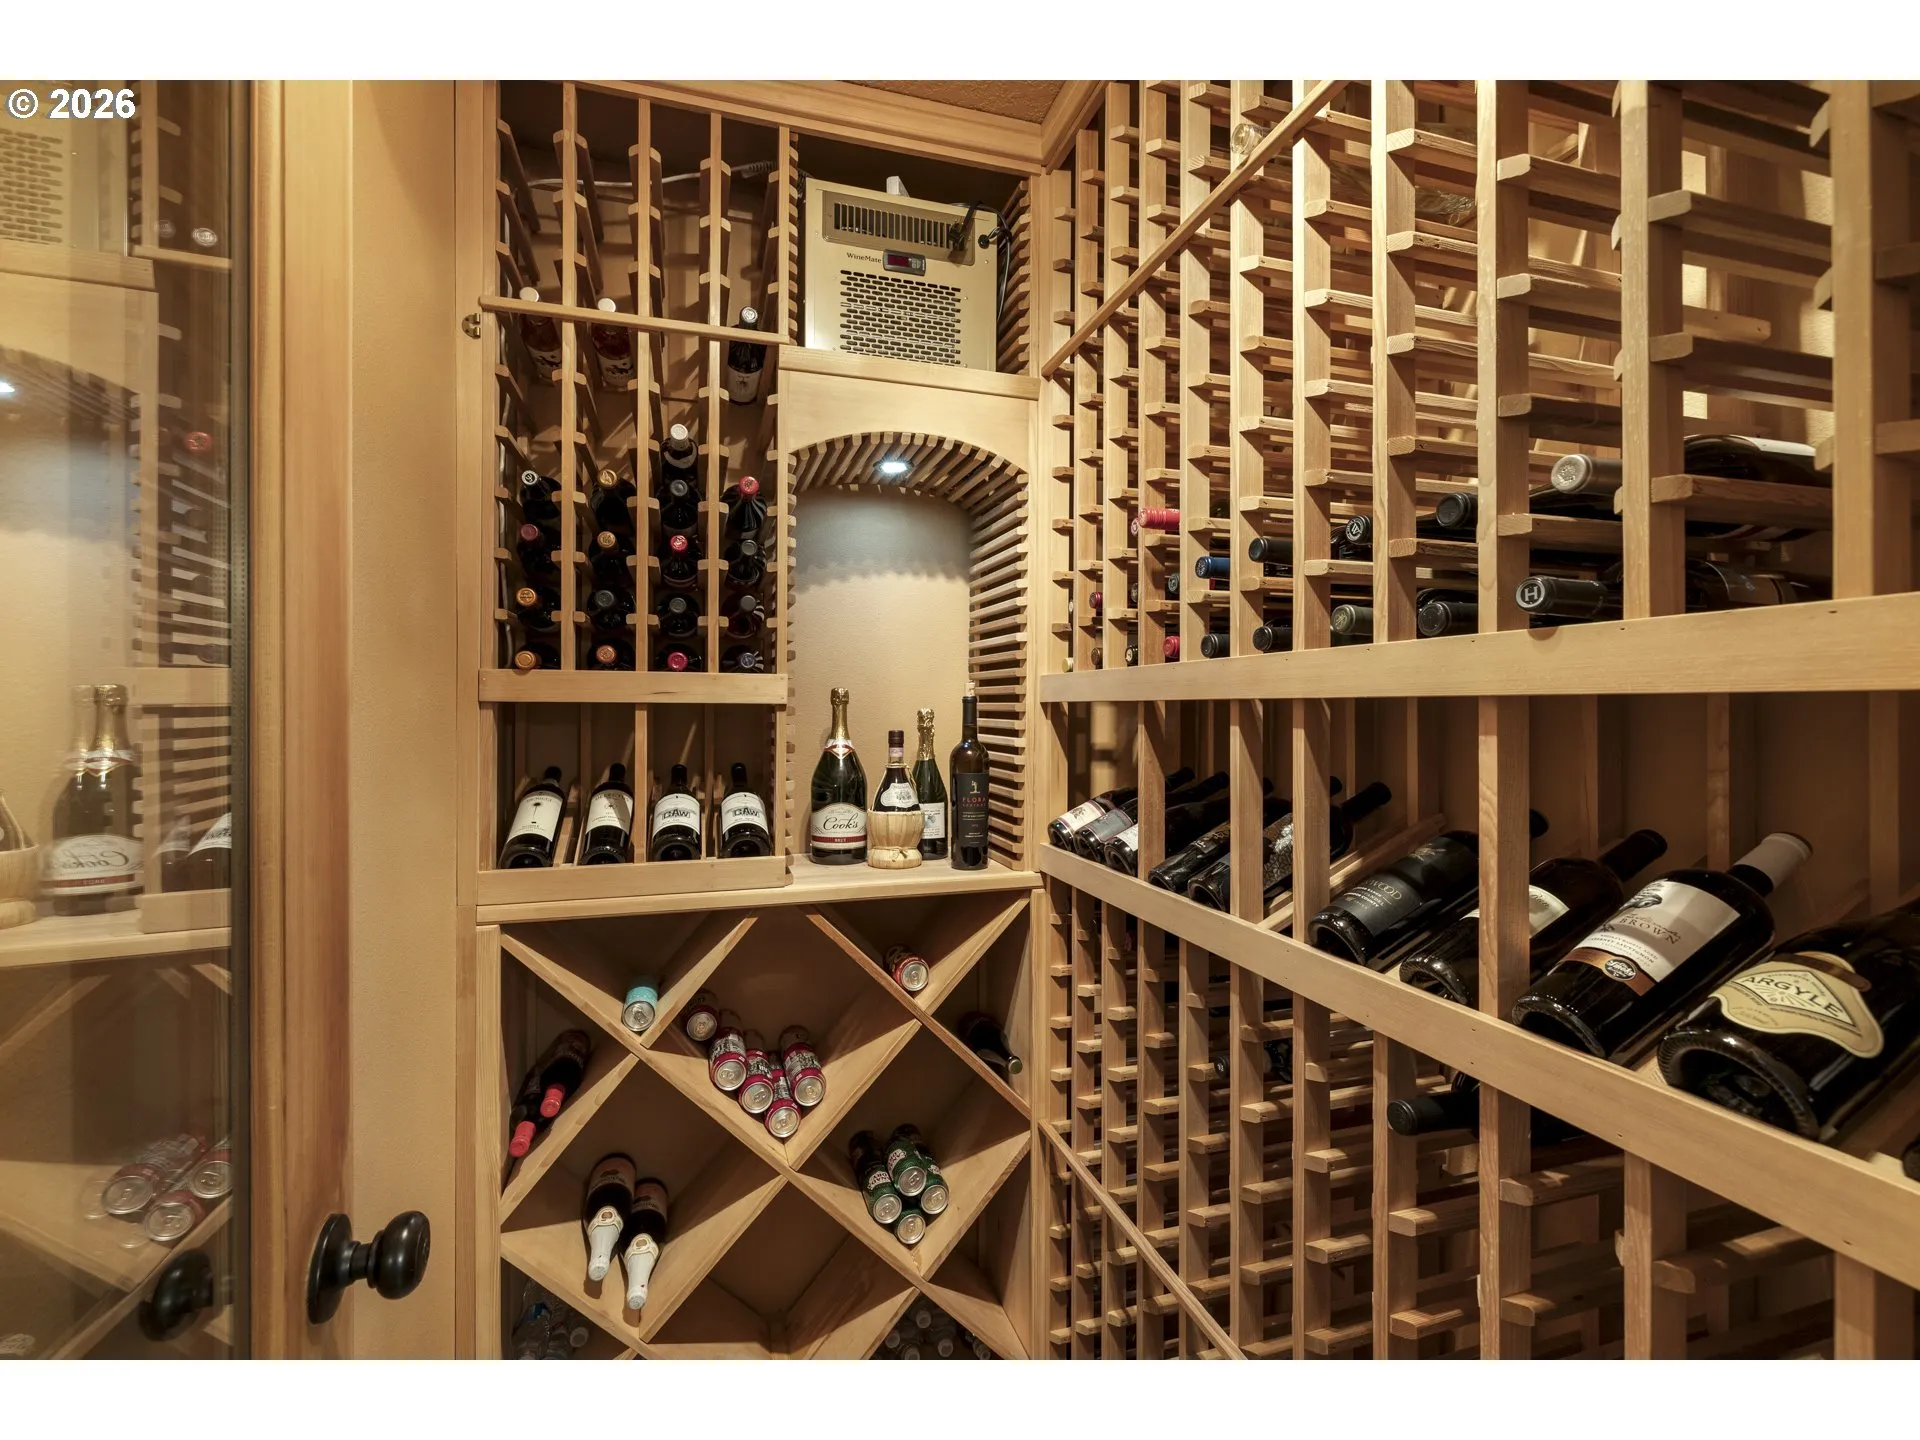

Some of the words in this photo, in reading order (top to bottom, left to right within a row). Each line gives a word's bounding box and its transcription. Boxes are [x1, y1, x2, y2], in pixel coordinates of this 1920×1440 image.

[846, 251, 882, 264] WineMate
[1523, 585, 1539, 602] H
[823, 812, 859, 831] Cook's
[1619, 917, 1680, 944] BROWN
[1742, 976, 1843, 1017] ARGYLE
